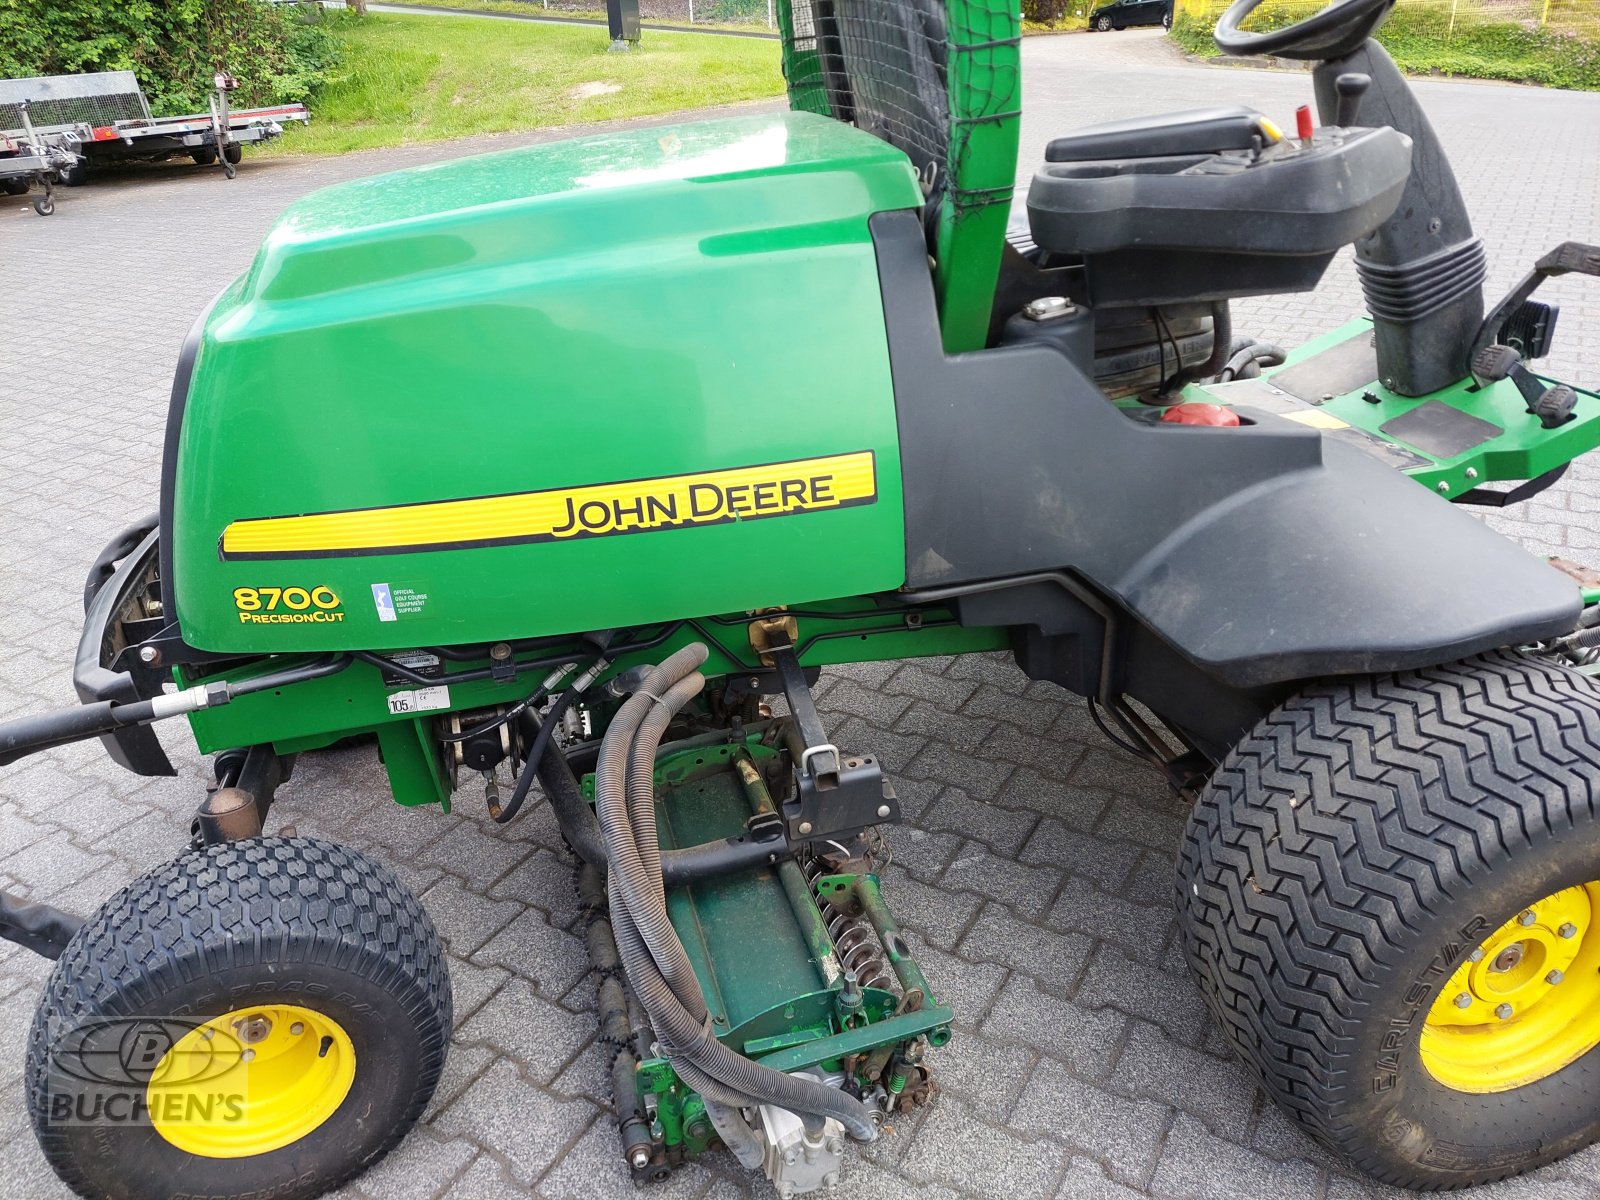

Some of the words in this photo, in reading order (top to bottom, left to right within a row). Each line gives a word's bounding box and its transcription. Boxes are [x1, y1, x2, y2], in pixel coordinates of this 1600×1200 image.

[551, 493, 679, 533] JOHN
[688, 475, 835, 518] DEERE
[393, 588, 415, 596] OFFICIAL
[408, 593, 428, 601] COURSE
[233, 584, 342, 612] 8700
[396, 600, 425, 608] EQUIPMENT
[398, 606, 422, 614] SUPPLIER
[390, 698, 409, 713] 105
[1371, 913, 1493, 1095] CARLSTAR
